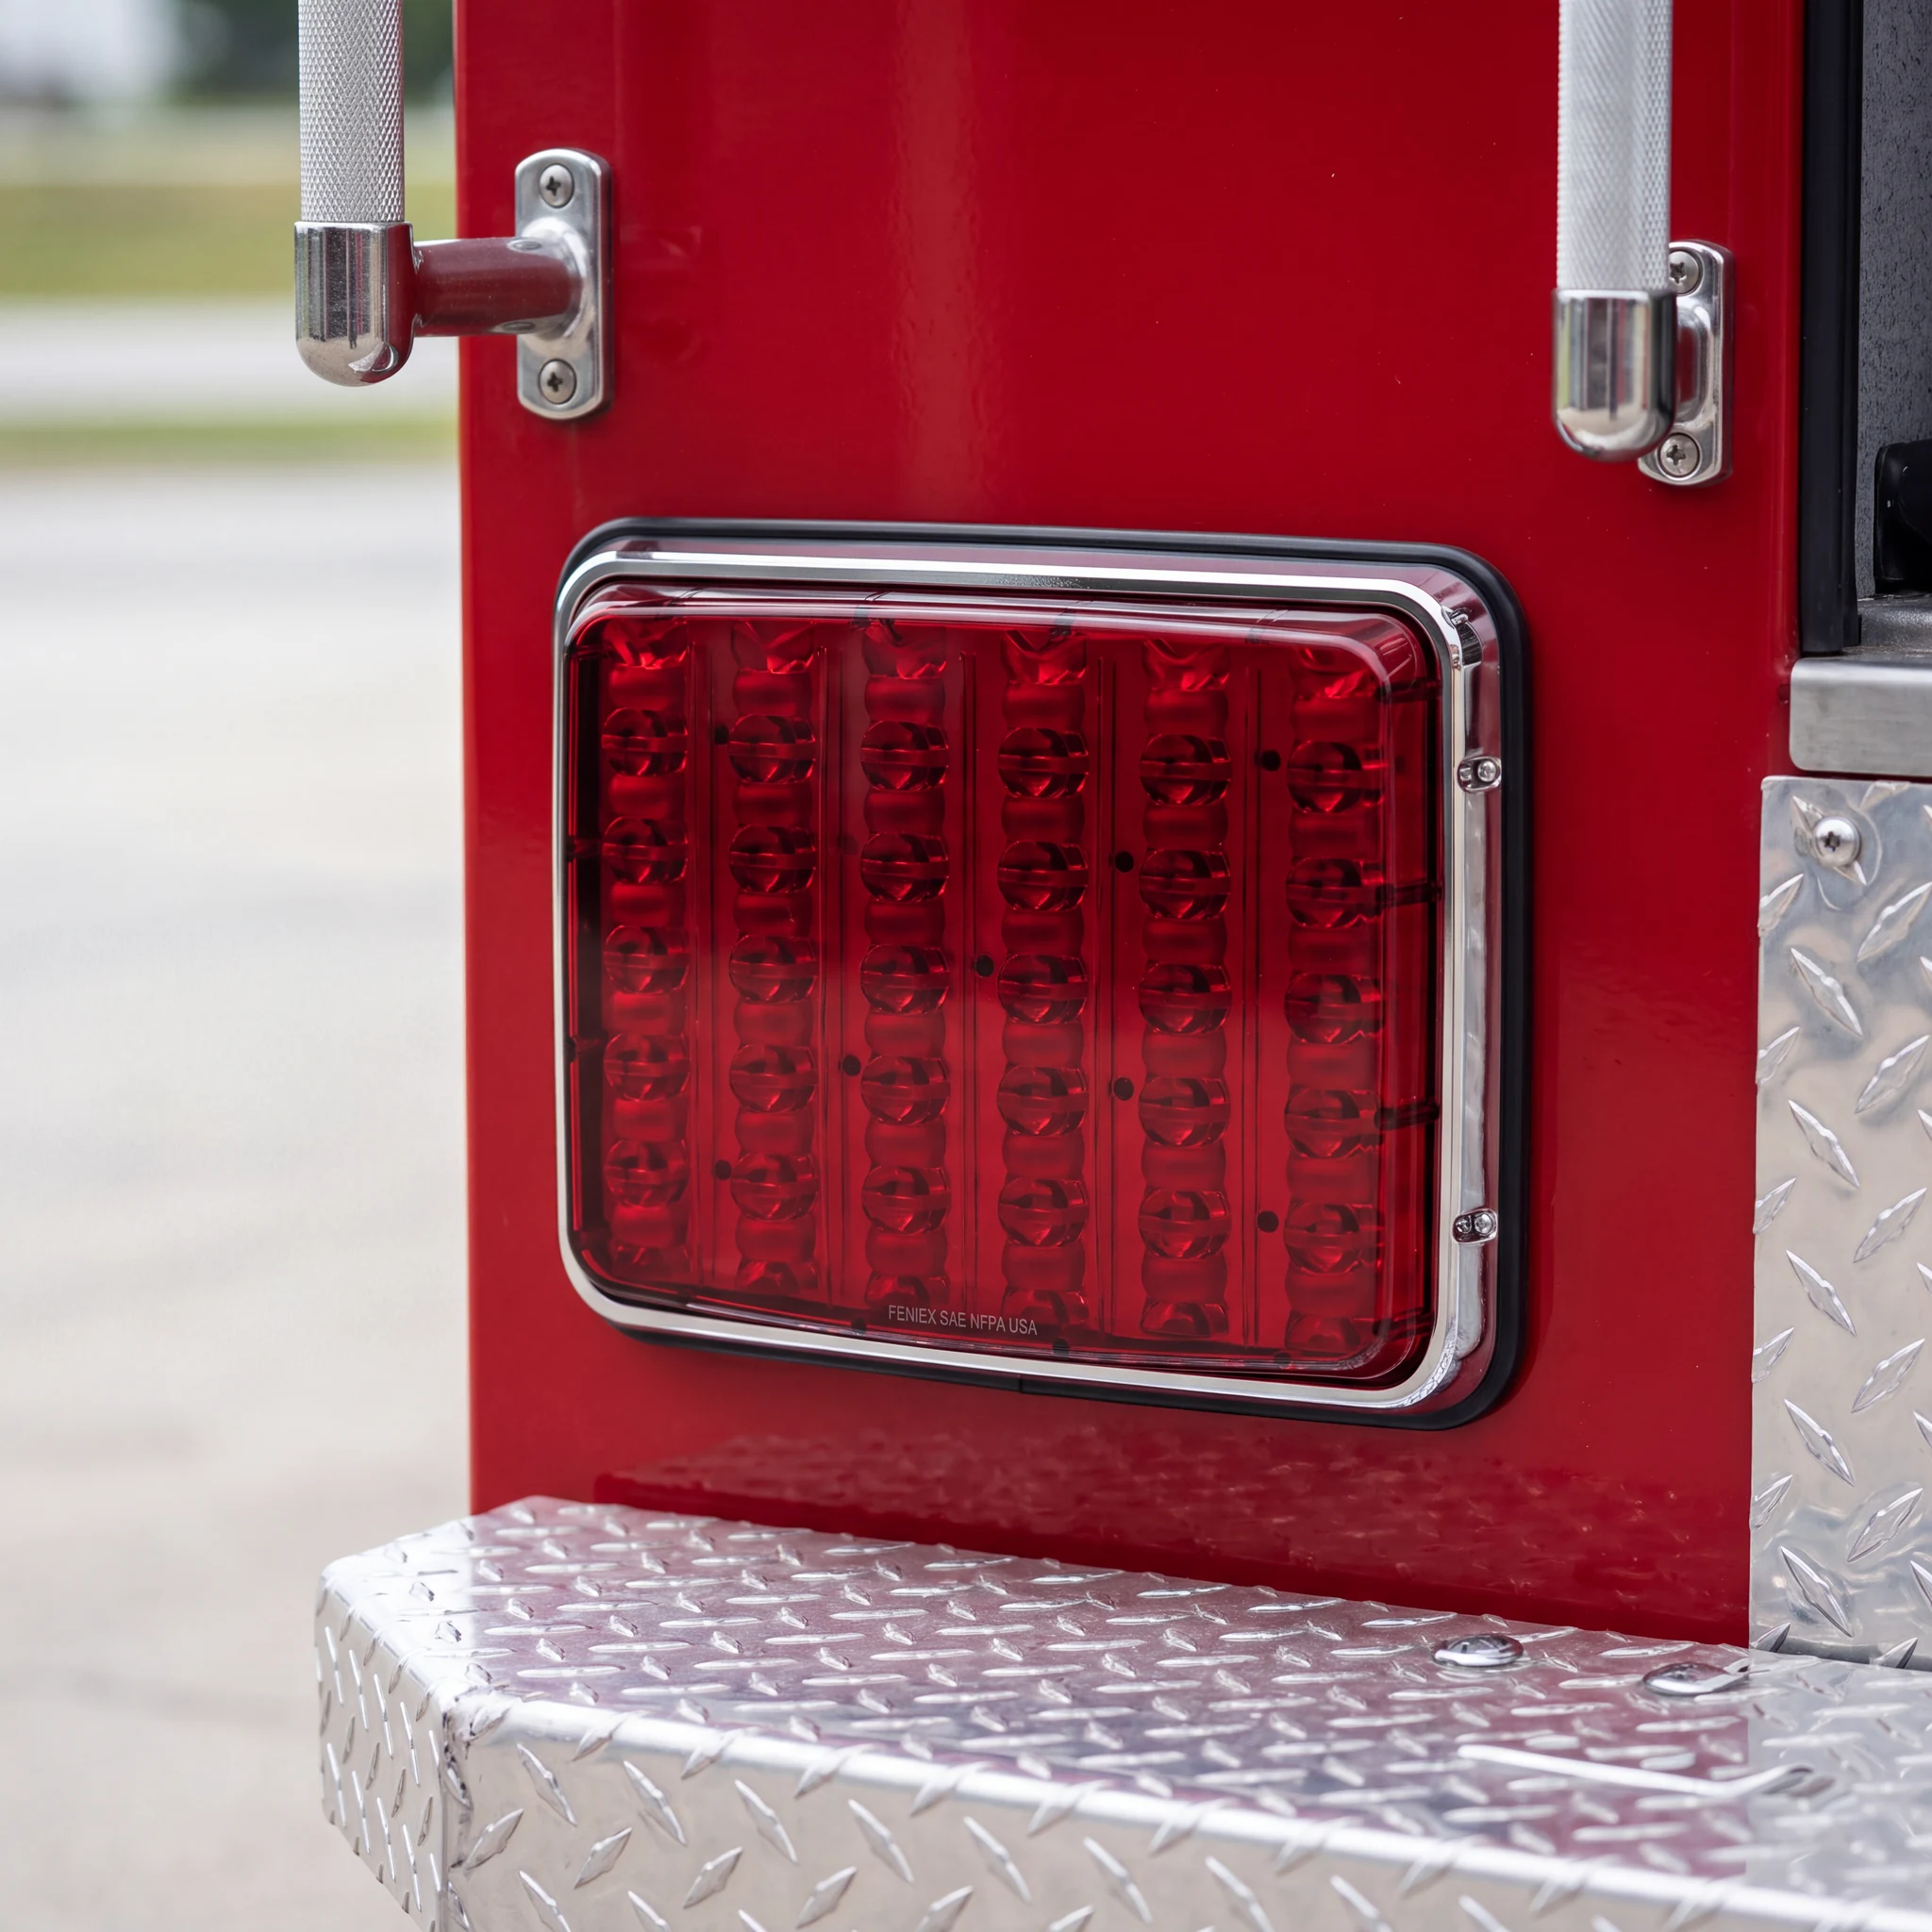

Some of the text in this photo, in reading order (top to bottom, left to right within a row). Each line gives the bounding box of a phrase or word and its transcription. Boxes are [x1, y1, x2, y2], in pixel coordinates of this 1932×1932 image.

[889, 1305, 1038, 1336] FENIEX SAE NFPA USA
